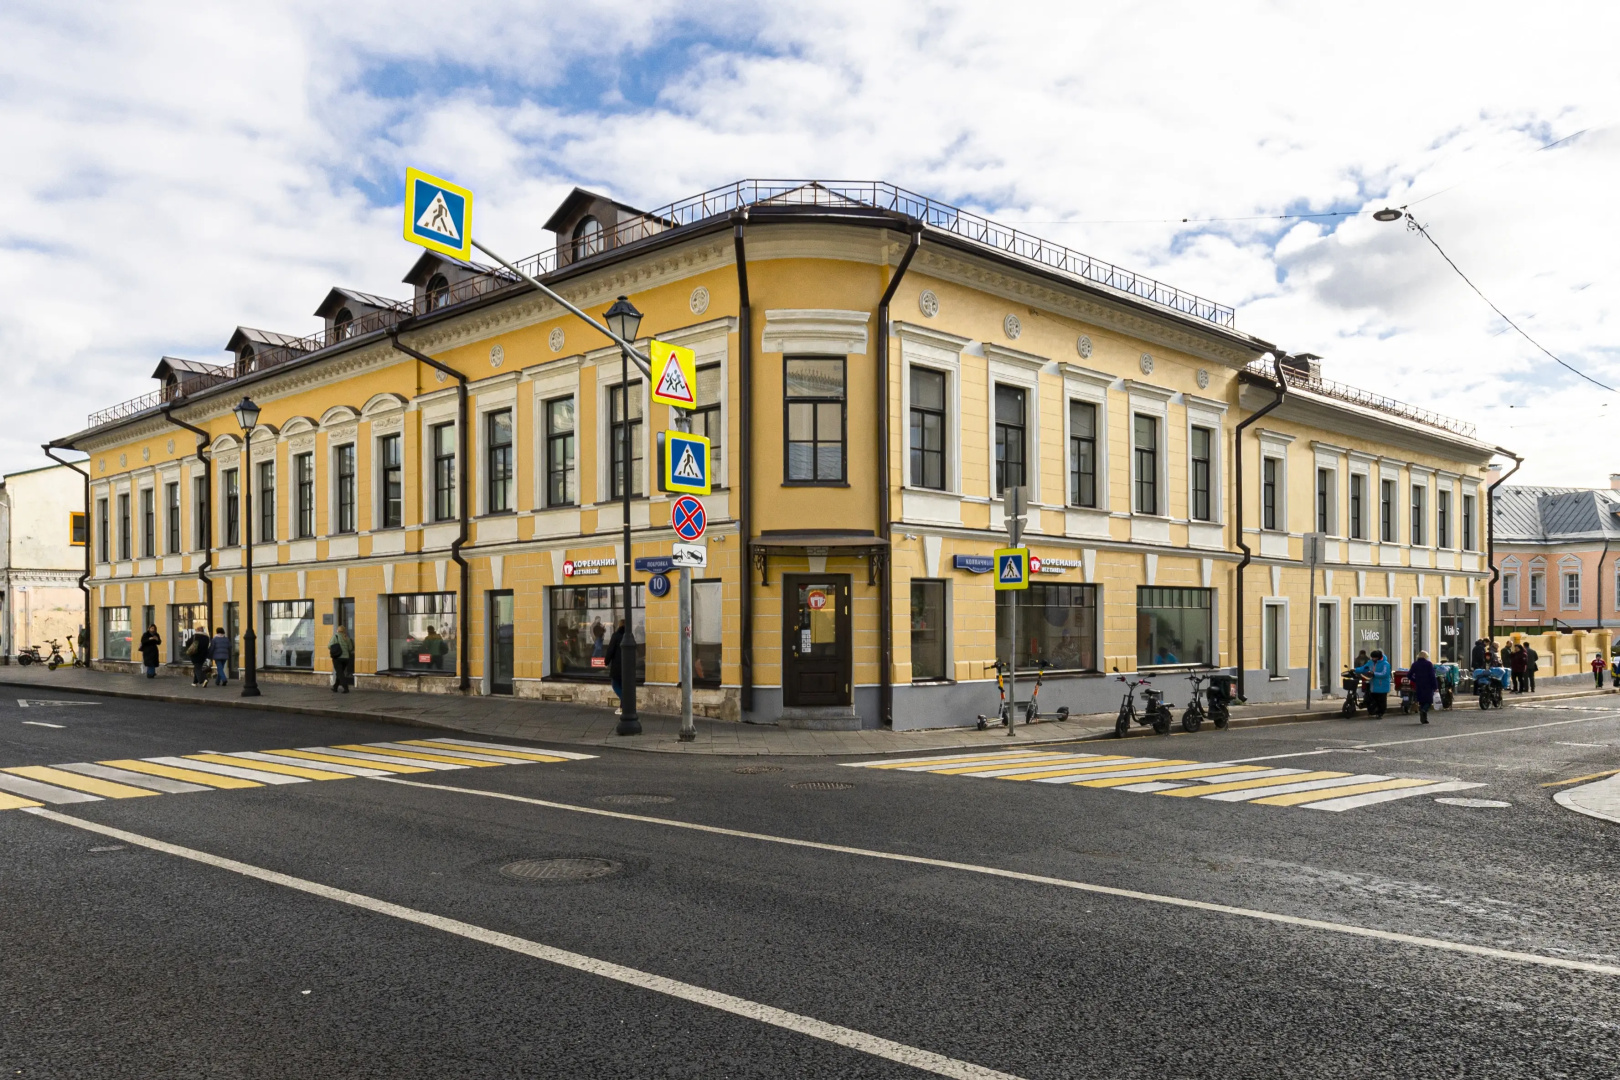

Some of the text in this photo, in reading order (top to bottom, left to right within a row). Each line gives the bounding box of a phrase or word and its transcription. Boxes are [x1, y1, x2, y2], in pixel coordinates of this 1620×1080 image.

[573, 558, 615, 567] КОФЕМАНИЯ
[1041, 559, 1081, 567] КОФЕМАНИЯ
[653, 578, 663, 590] 10
